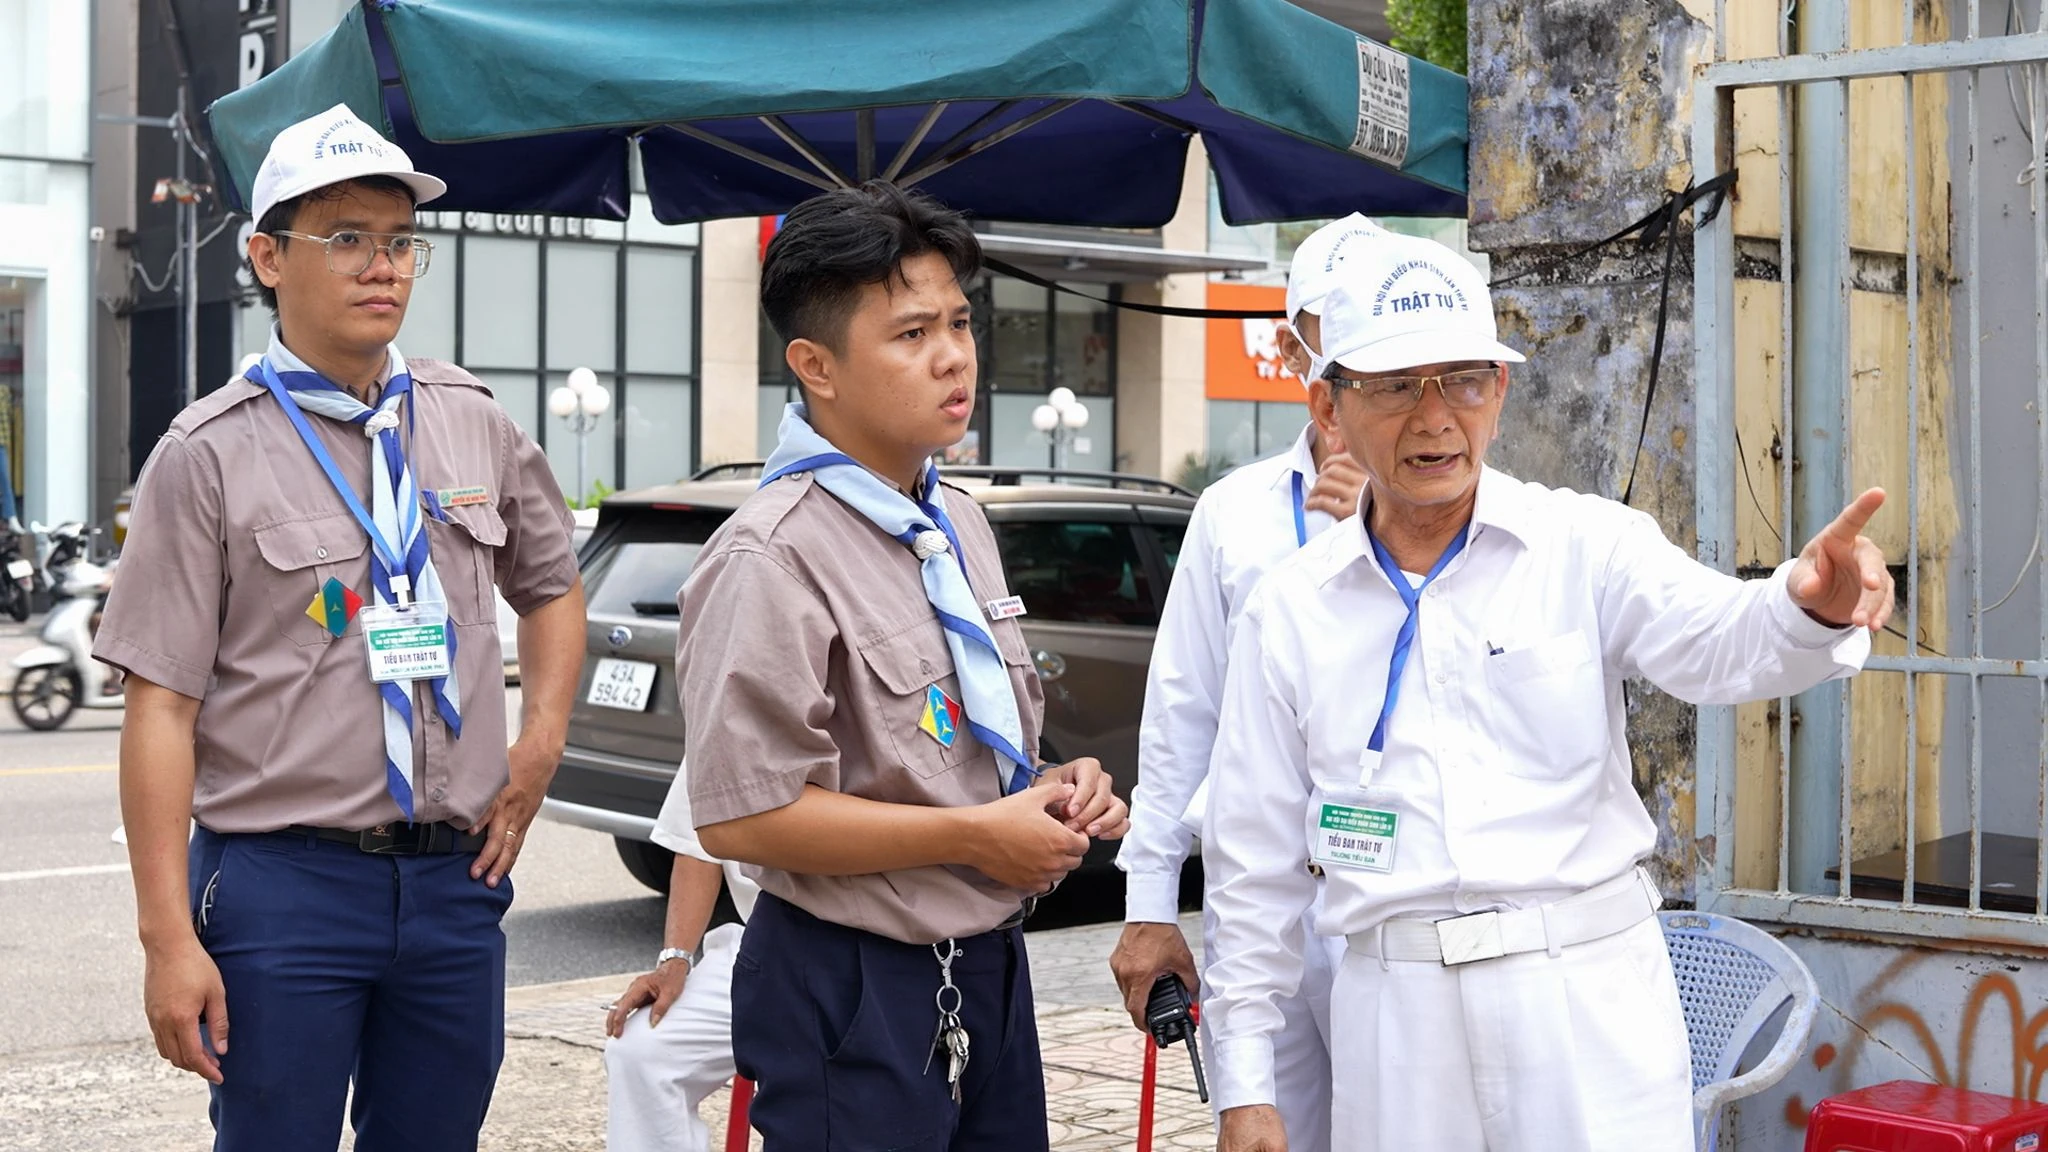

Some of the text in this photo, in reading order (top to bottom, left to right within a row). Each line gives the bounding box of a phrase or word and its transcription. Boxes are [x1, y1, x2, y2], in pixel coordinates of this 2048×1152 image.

[1390, 290, 1431, 313] TRẬT
[610, 664, 636, 683] 43A
[594, 683, 641, 707] 594.42
[1328, 832, 1341, 848] TIỂU
[1342, 837, 1356, 849] BAN
